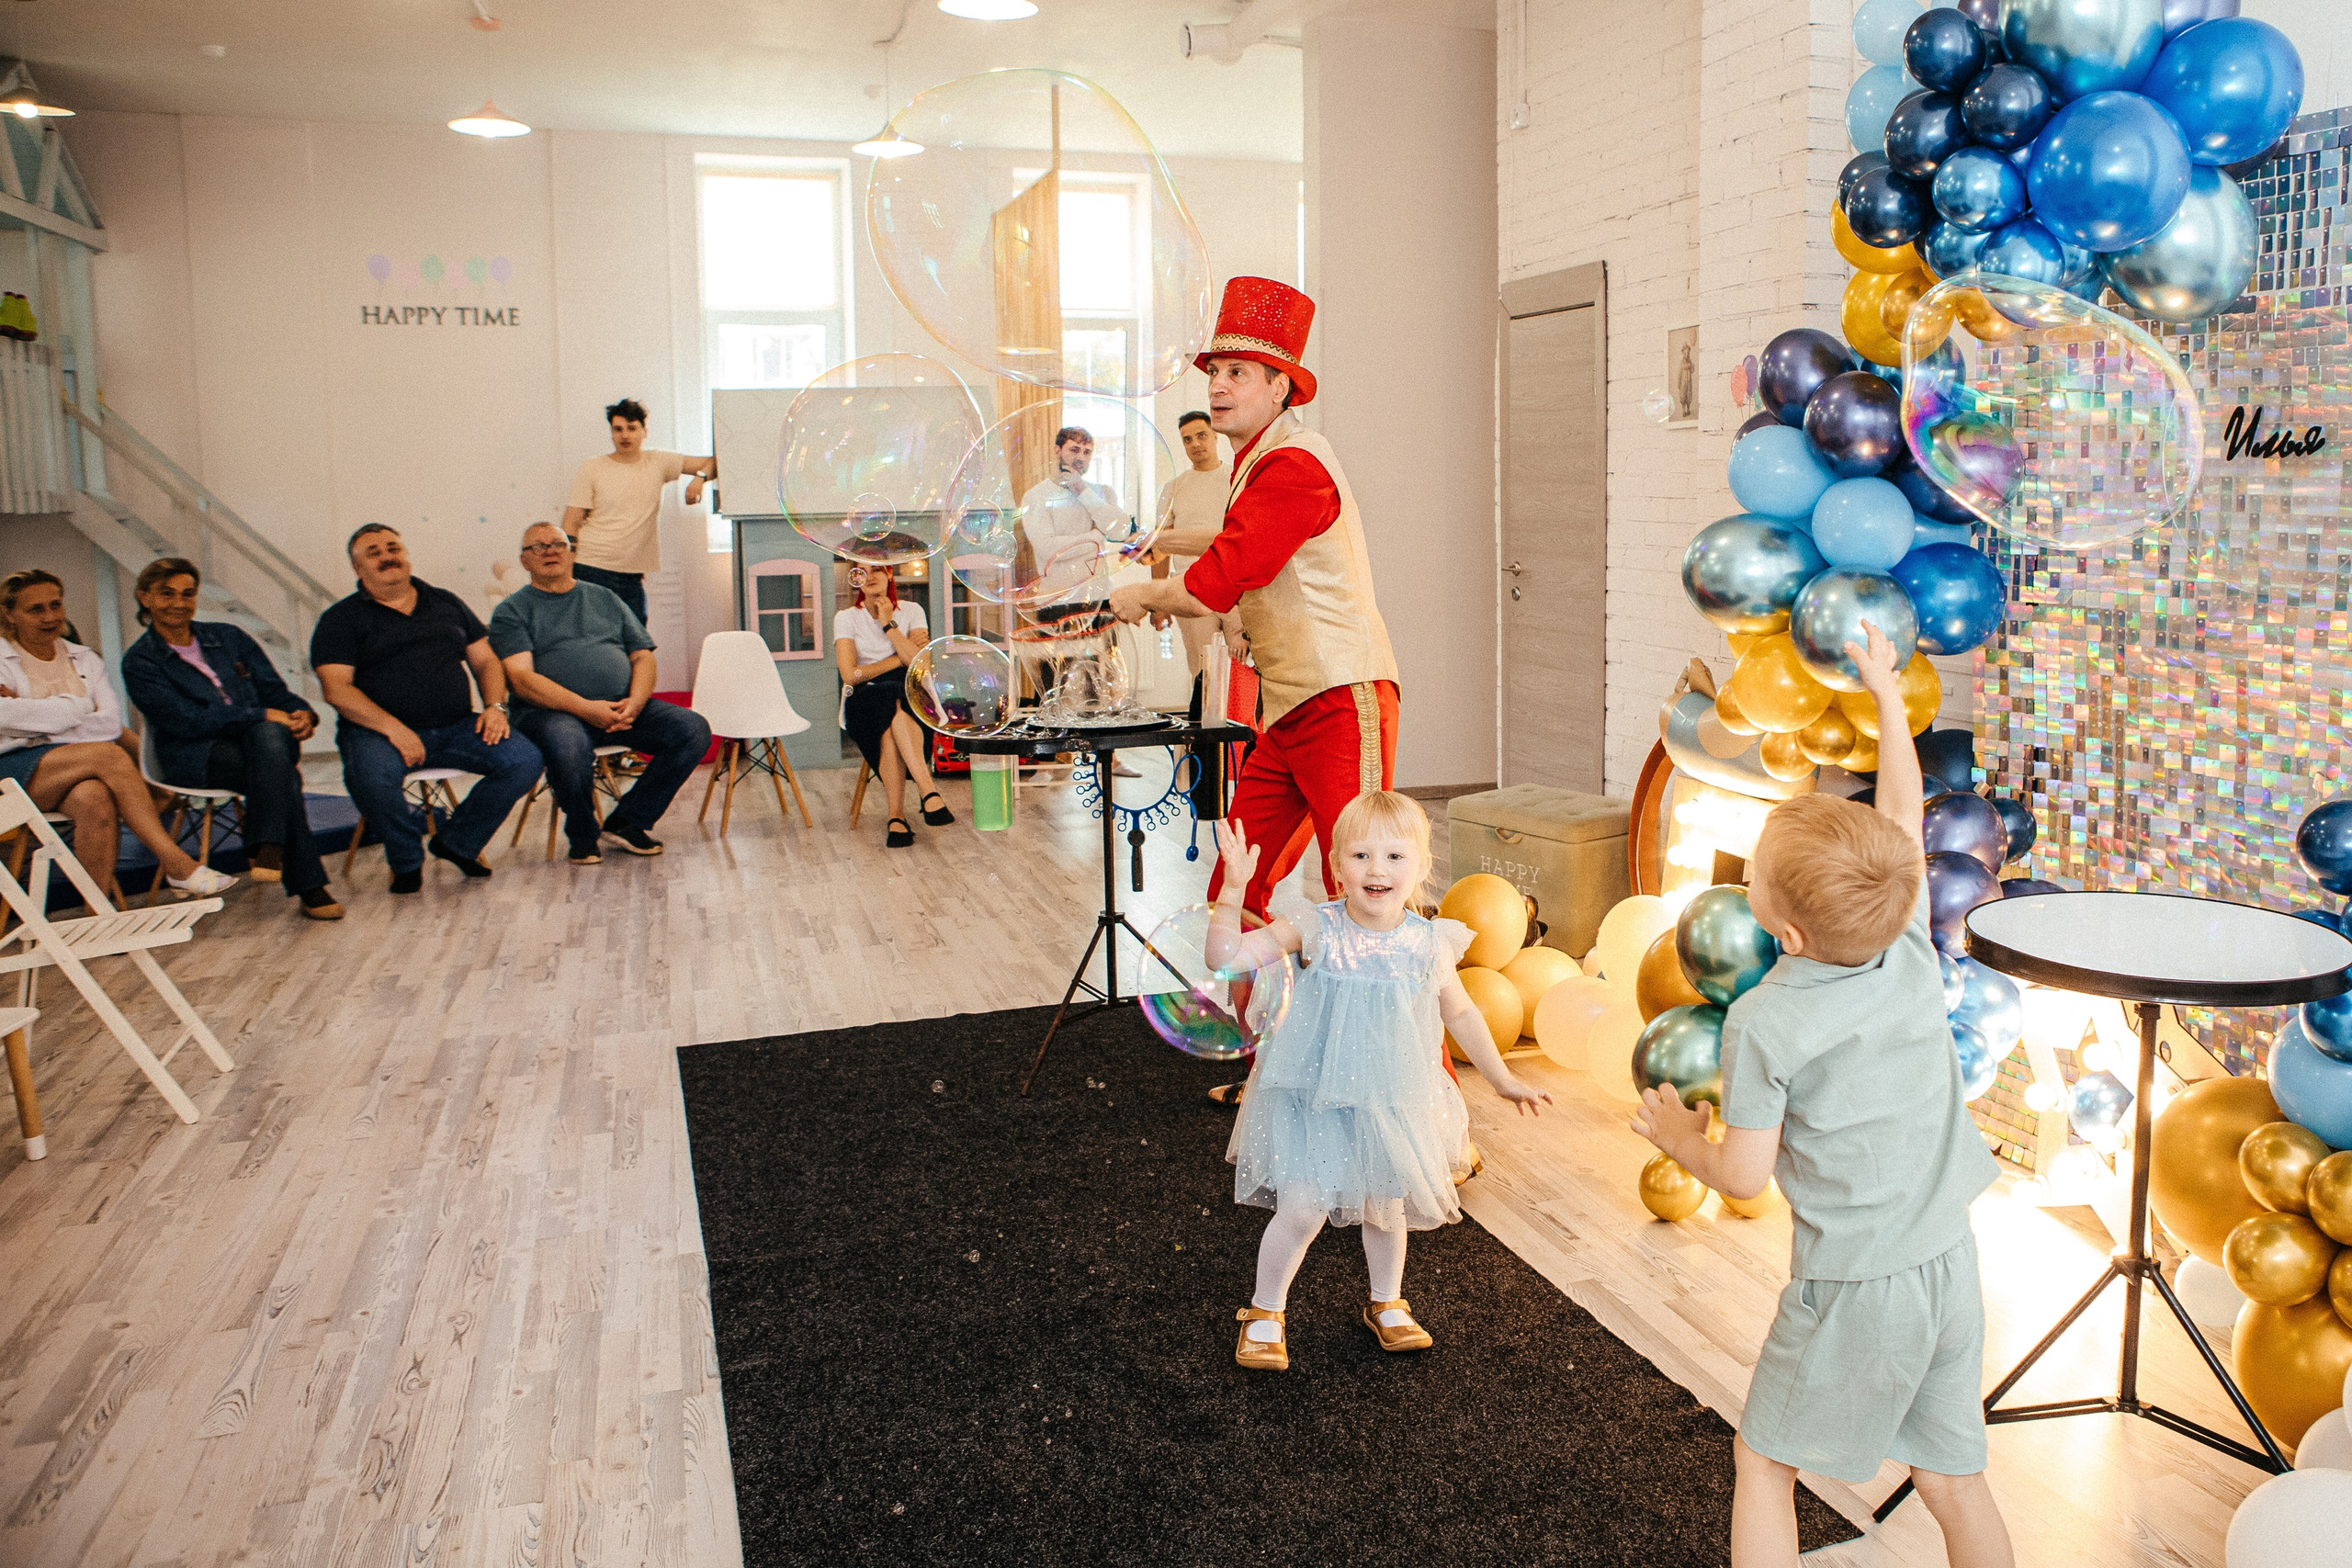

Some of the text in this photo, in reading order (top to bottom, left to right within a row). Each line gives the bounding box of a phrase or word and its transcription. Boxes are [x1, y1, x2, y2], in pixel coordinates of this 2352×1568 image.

[361, 305, 520, 326] HAPPY TIME
[2223, 405, 2326, 461] Илья
[1480, 854, 1541, 884] HAPPY
